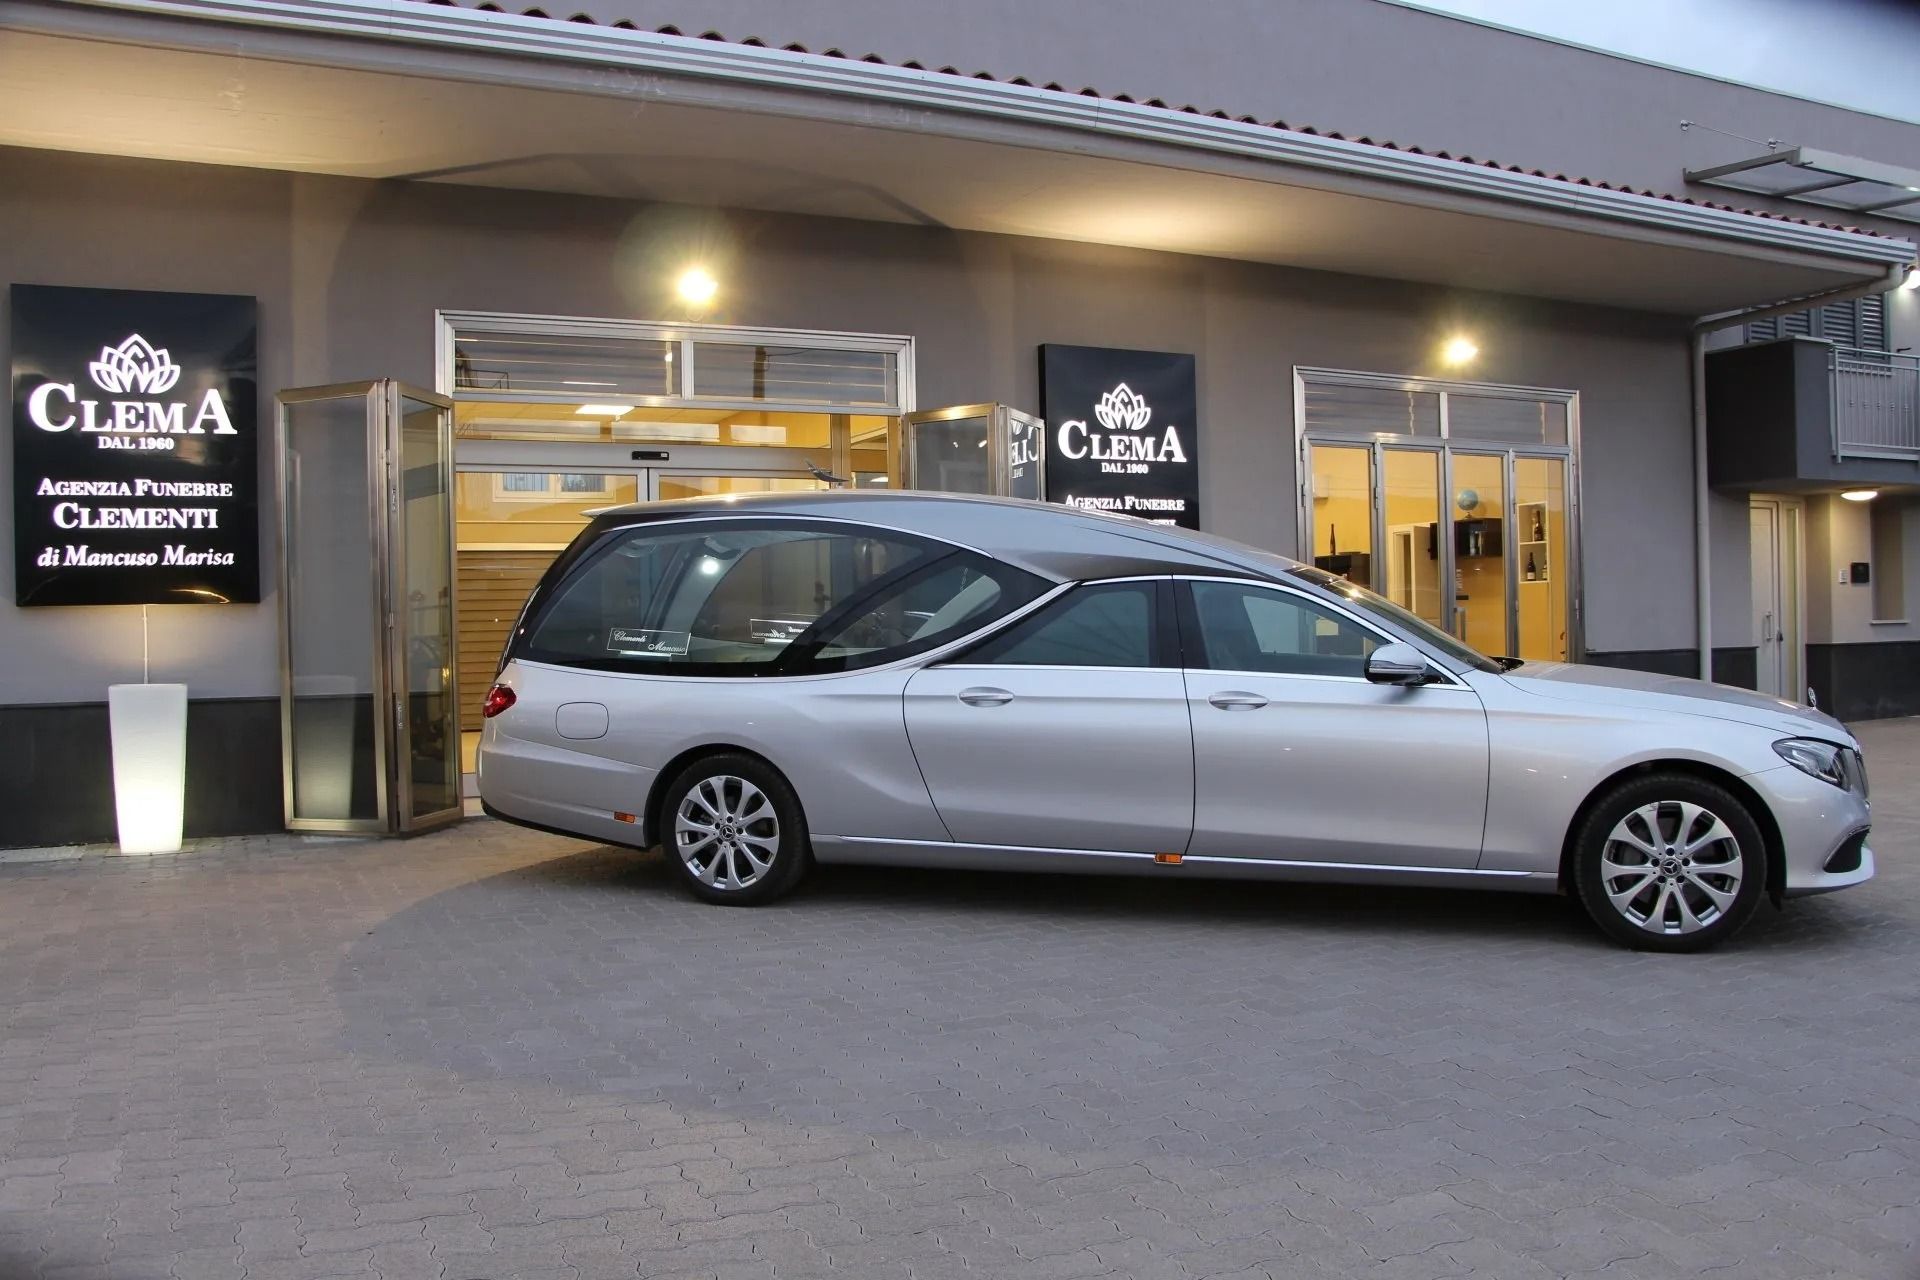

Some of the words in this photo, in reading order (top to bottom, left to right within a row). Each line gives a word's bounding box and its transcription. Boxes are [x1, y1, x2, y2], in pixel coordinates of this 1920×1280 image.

[29, 383, 237, 434] CLEMA
[98, 437, 135, 449] DAL
[140, 437, 174, 450] 1960
[1058, 420, 1187, 463] CLEMA
[1101, 462, 1125, 473] DAL
[1127, 463, 1149, 474] 1960
[37, 478, 132, 497] AGENZIA
[134, 479, 233, 497] FUNEBRE
[1065, 494, 1122, 509] AGENZIA
[1124, 496, 1185, 511] FUNEBRE
[53, 502, 219, 529] CLEMENTI
[37, 547, 60, 567] di
[63, 545, 159, 567] Mancuso
[162, 545, 235, 566] Marisa
[613, 630, 648, 642] Clementi
[648, 641, 686, 652] Mancuso
